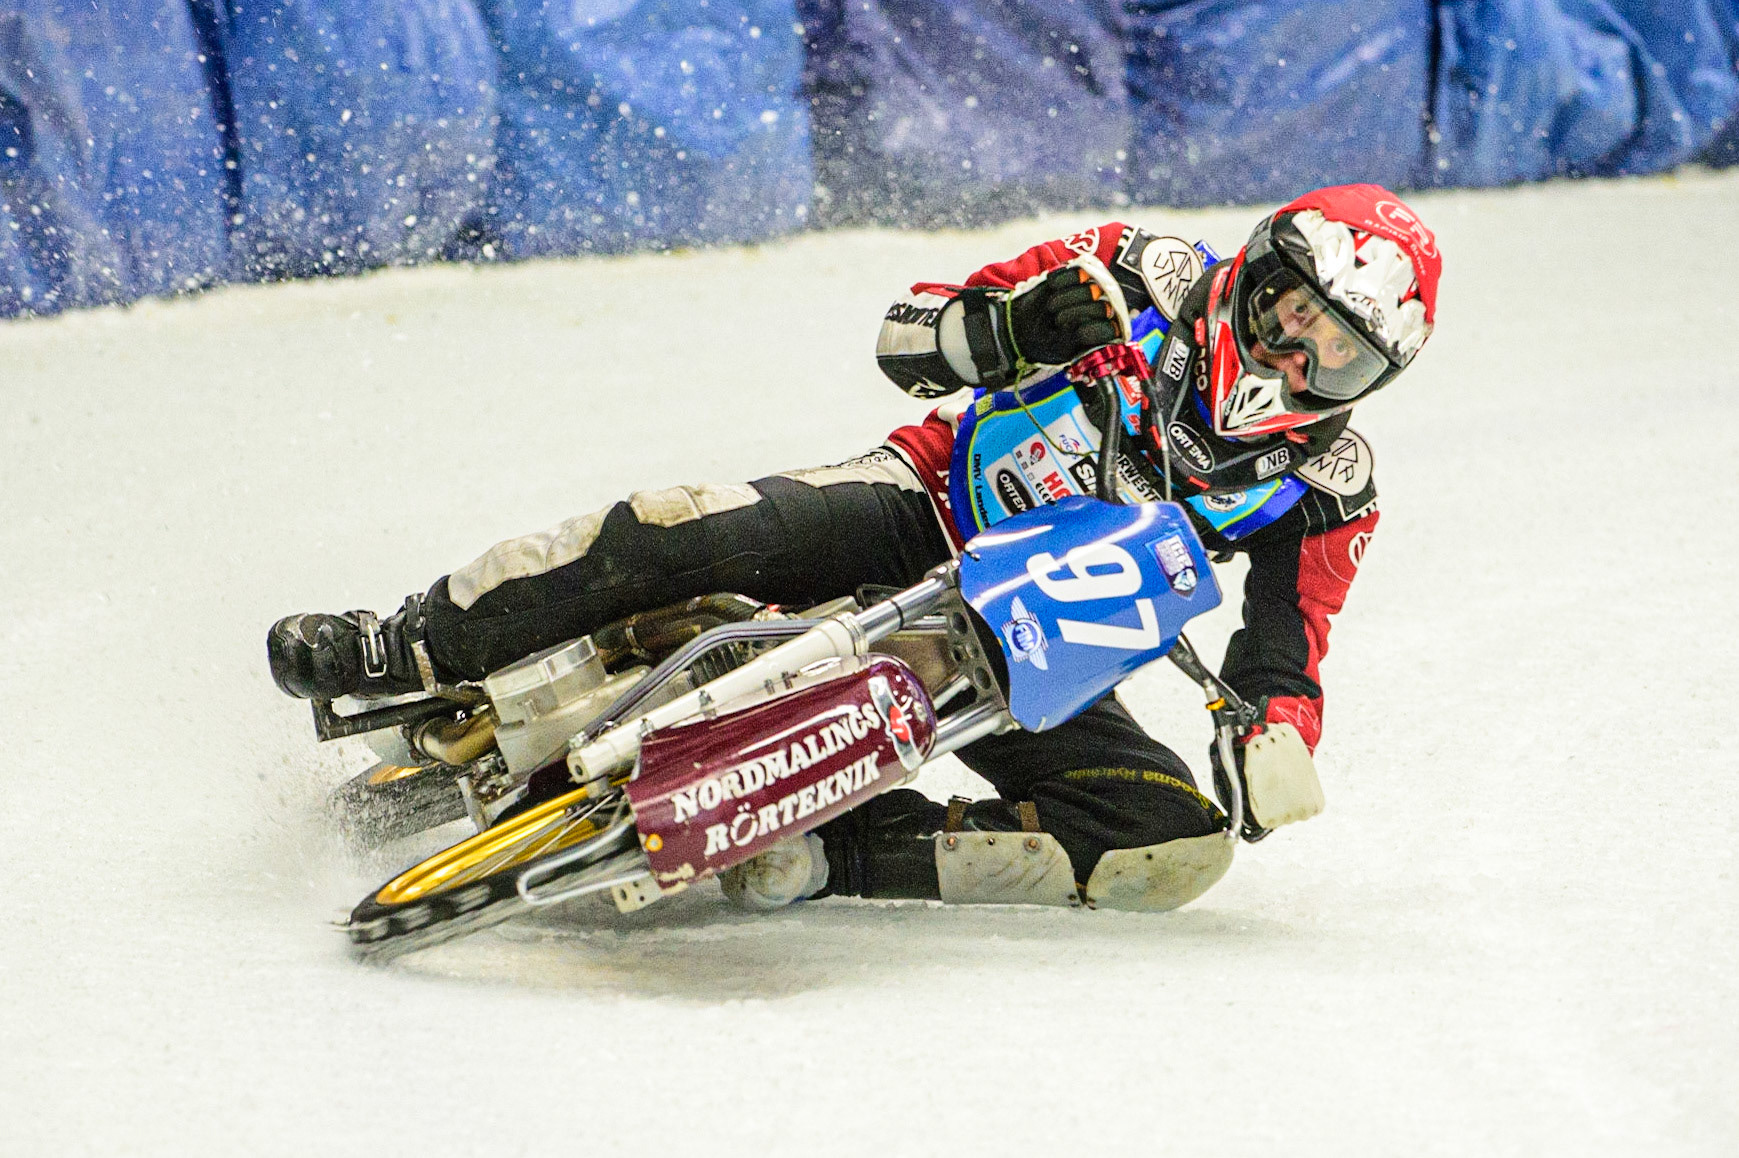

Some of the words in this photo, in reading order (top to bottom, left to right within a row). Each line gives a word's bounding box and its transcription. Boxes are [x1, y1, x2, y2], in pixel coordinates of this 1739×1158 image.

[1170, 426, 1211, 470] ORTEMA
[1015, 624, 1035, 650] FIM
[1026, 542, 1161, 650] 97
[670, 701, 882, 824] NORDMALINGS
[704, 751, 882, 858] RÖRTEKNIK
